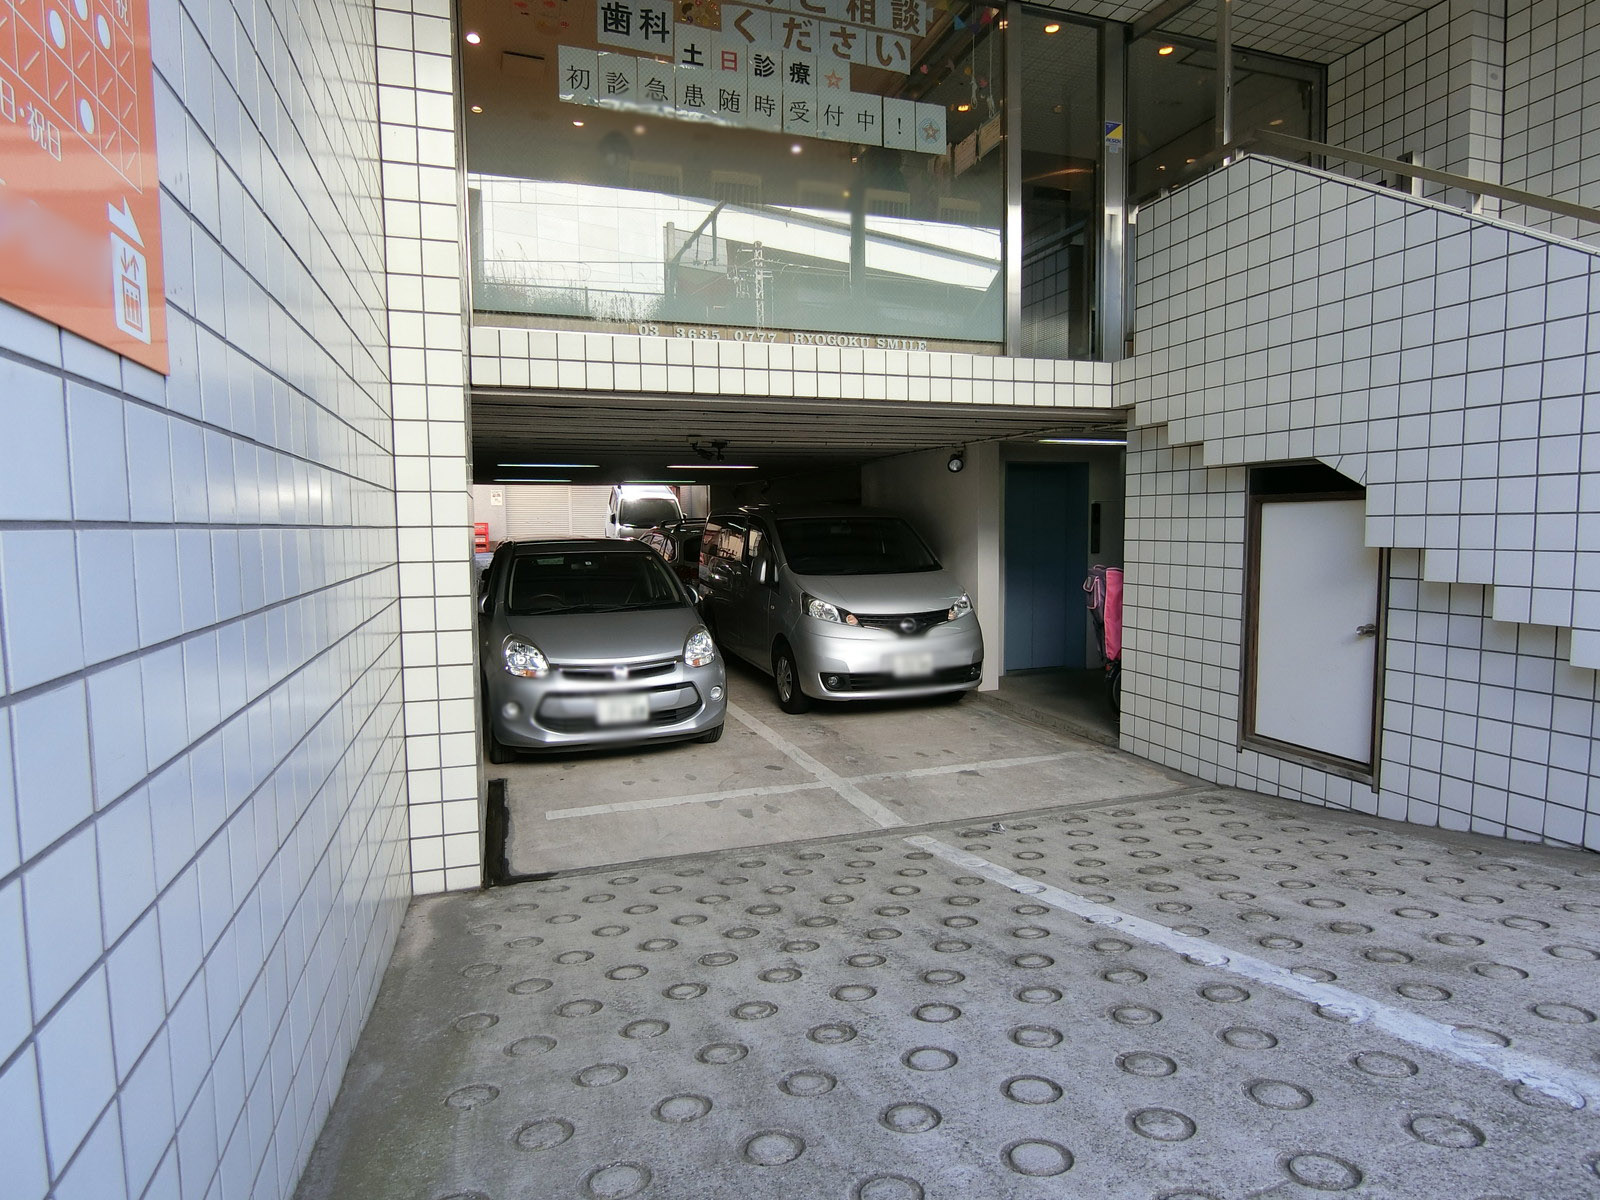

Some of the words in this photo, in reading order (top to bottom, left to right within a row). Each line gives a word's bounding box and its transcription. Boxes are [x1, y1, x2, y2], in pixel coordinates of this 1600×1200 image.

[601, 1, 670, 43] 歯科
[733, 9, 906, 67] ください
[682, 43, 811, 85] 土日診療
[638, 325, 660, 337] 03
[676, 327, 721, 341] 3635
[734, 329, 778, 343] 0777
[793, 332, 871, 349] RYOGOKU
[877, 338, 928, 352] SMILE
